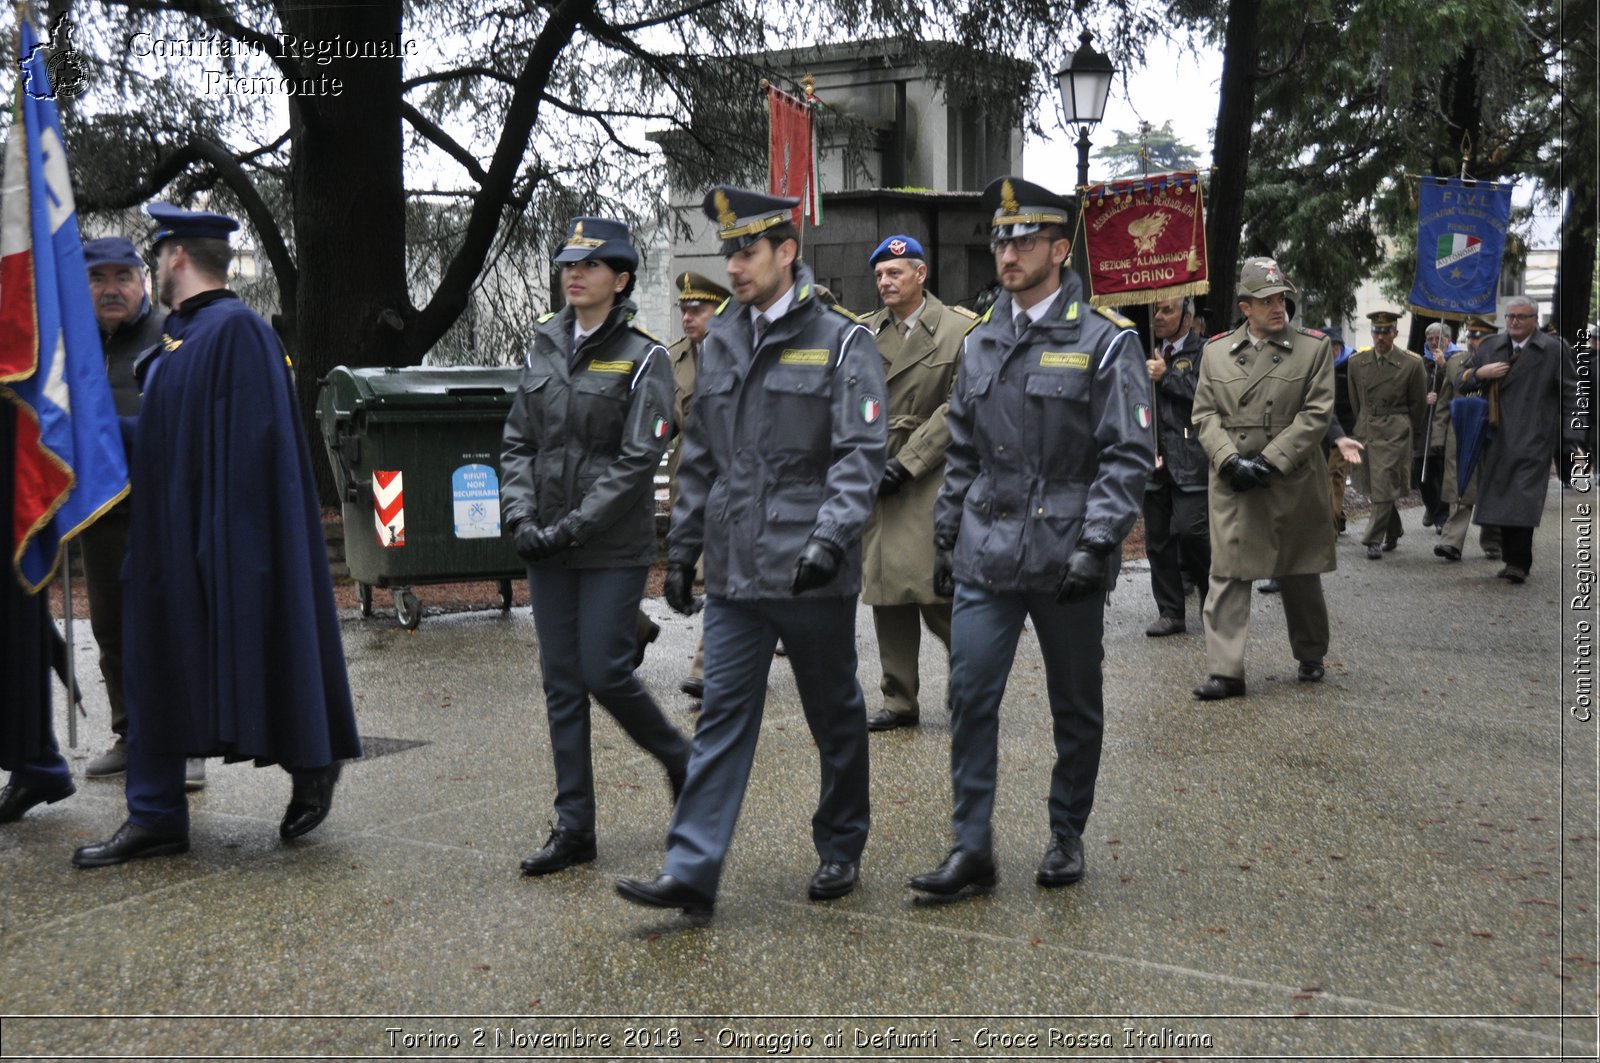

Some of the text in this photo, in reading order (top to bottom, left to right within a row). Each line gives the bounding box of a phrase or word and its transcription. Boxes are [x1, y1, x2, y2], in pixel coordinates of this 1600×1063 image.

[1099, 258, 1131, 271] SEZIONE
[1122, 268, 1175, 285] TORINO
[463, 472, 487, 480] RIFIUTI
[466, 481, 485, 489] NON
